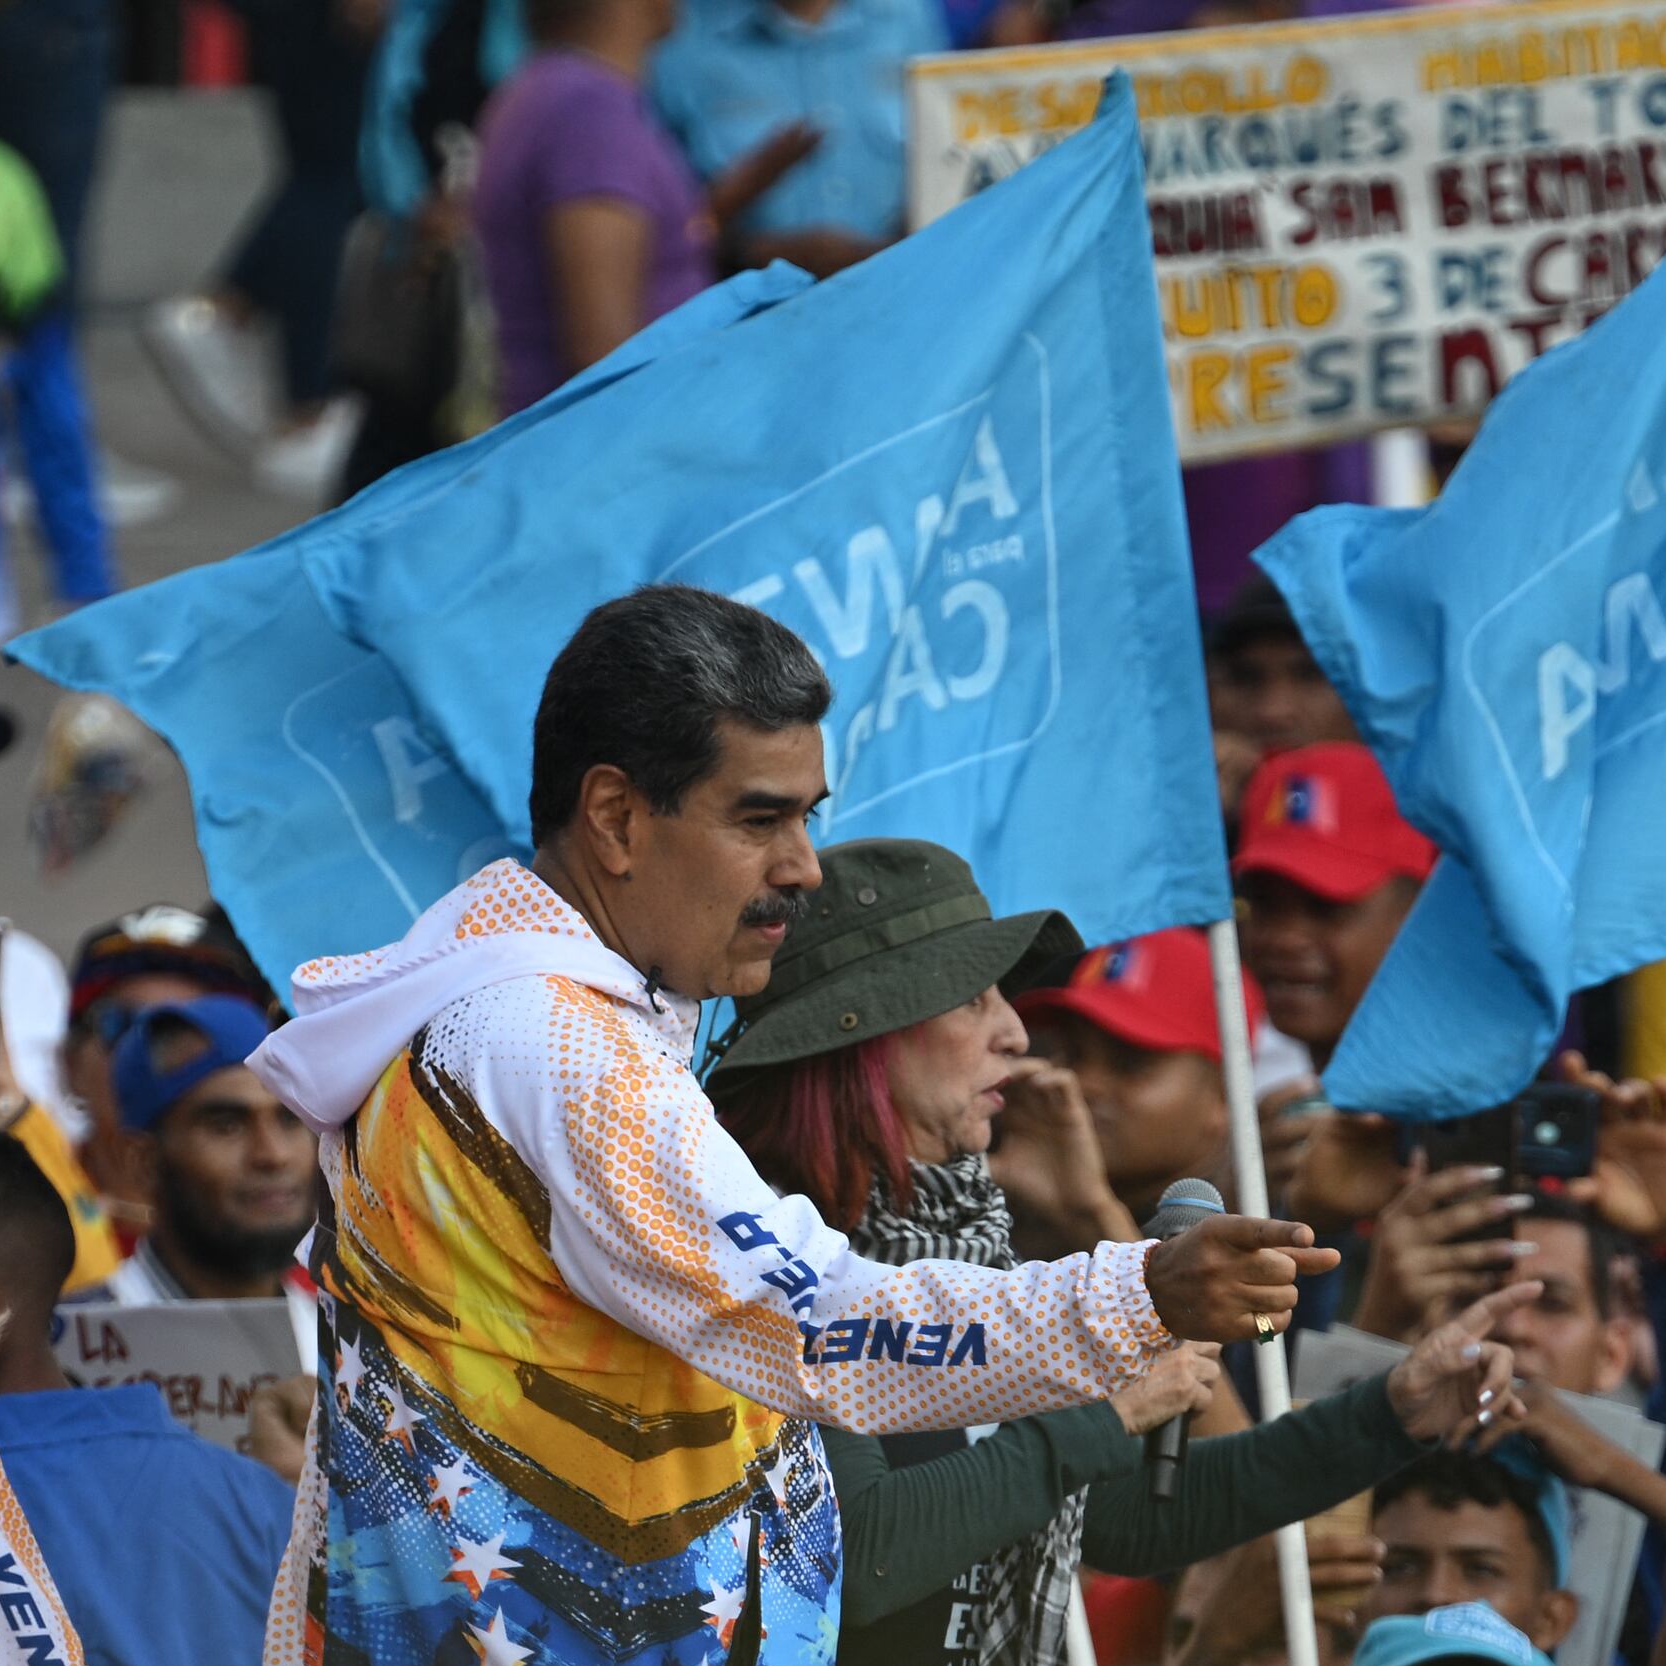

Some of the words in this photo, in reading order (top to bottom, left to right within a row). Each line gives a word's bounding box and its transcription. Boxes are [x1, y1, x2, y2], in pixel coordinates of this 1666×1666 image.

[1440, 87, 1551, 152] DEL
[1362, 250, 1409, 327] 3
[76, 1313, 129, 1363] LA
